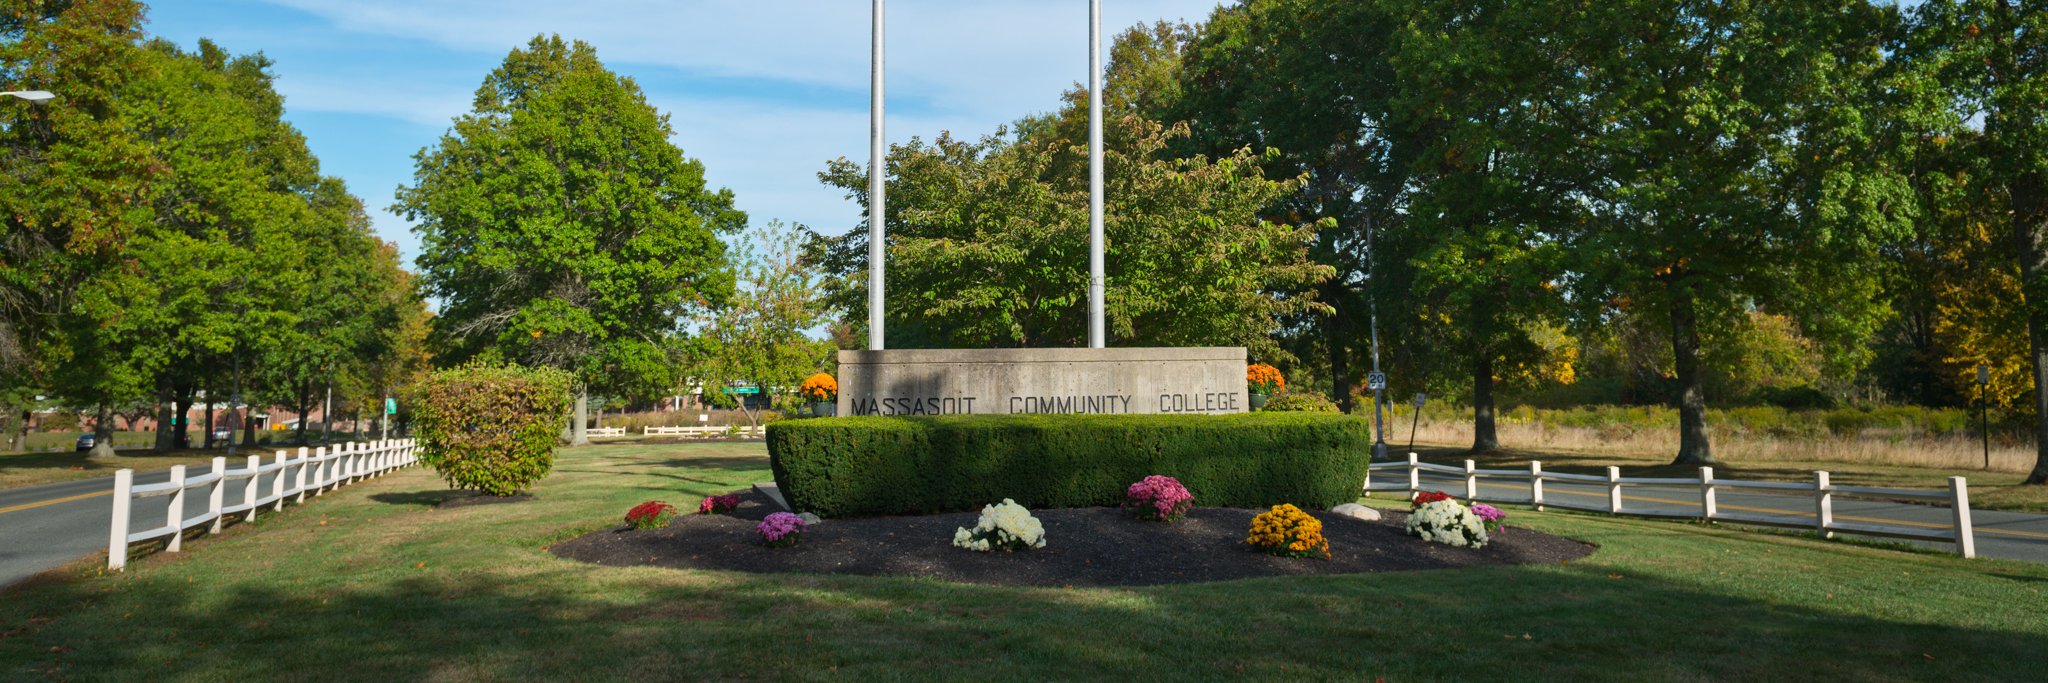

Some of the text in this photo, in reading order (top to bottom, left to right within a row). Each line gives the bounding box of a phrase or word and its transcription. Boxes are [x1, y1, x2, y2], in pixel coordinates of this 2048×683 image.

[1369, 374, 1384, 384] 20
[851, 392, 1239, 416] MASSASOIT COMMUNITY COLLEGE
